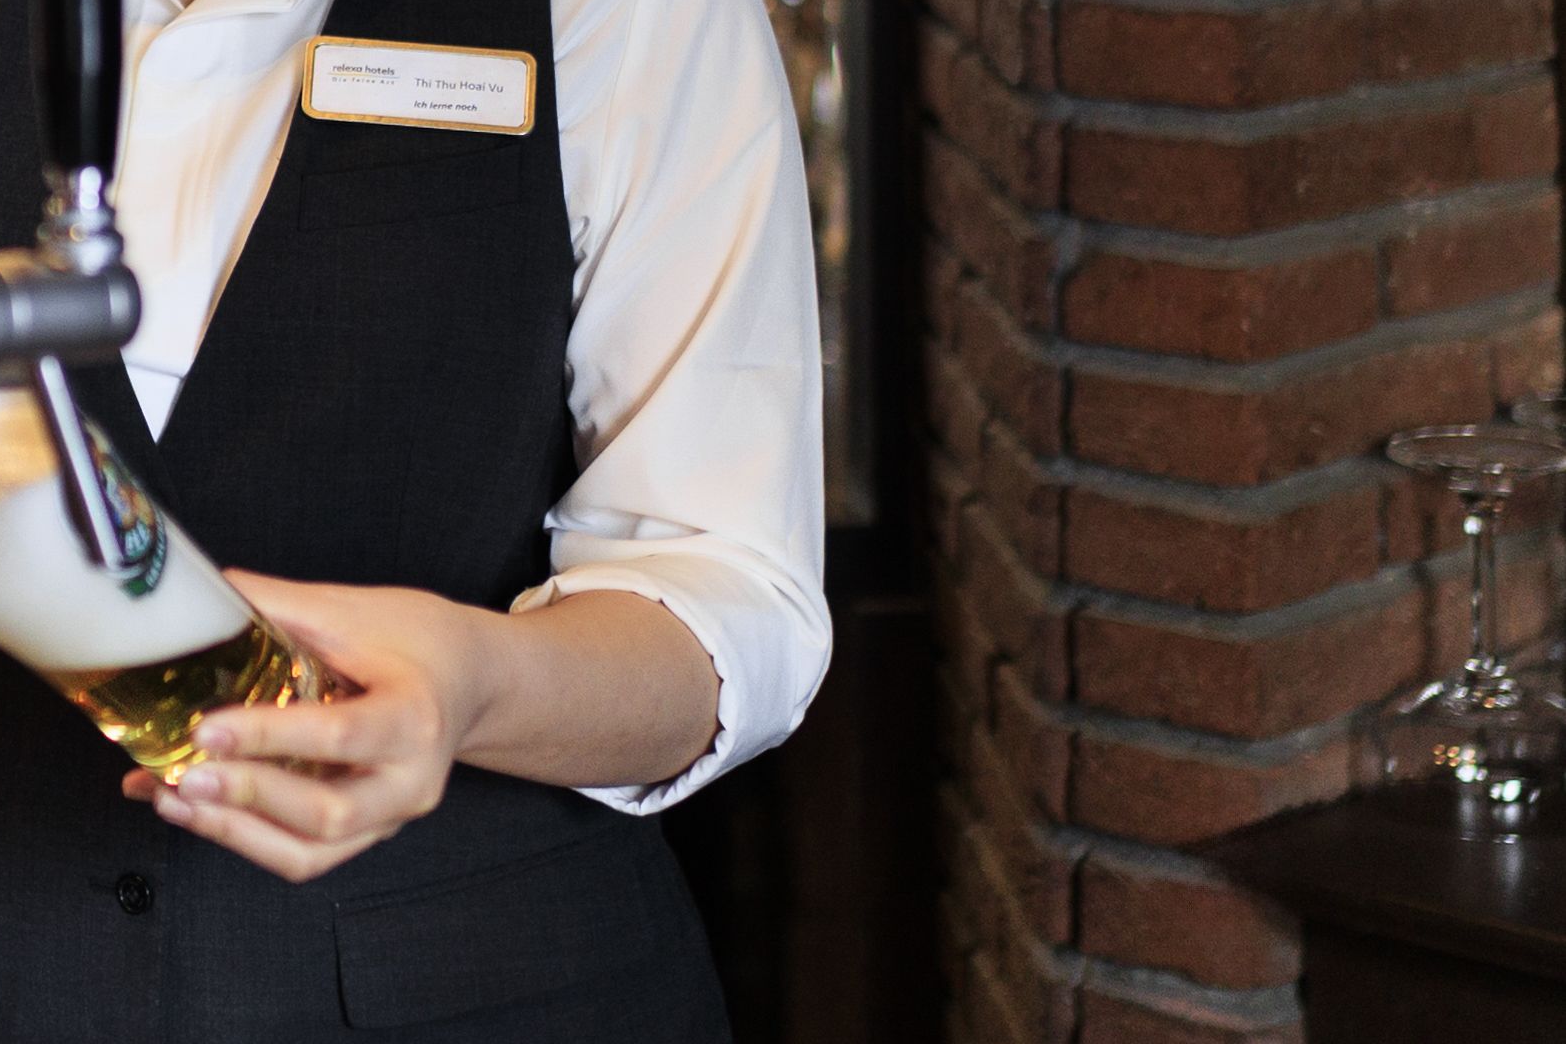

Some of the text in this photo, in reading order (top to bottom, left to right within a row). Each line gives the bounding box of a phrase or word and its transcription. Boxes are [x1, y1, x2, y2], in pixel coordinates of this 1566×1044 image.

[332, 64, 395, 75] relexa hotels
[415, 78, 504, 93] Thi Thu Hoai Vu
[413, 100, 478, 112] Ich lerne noch
